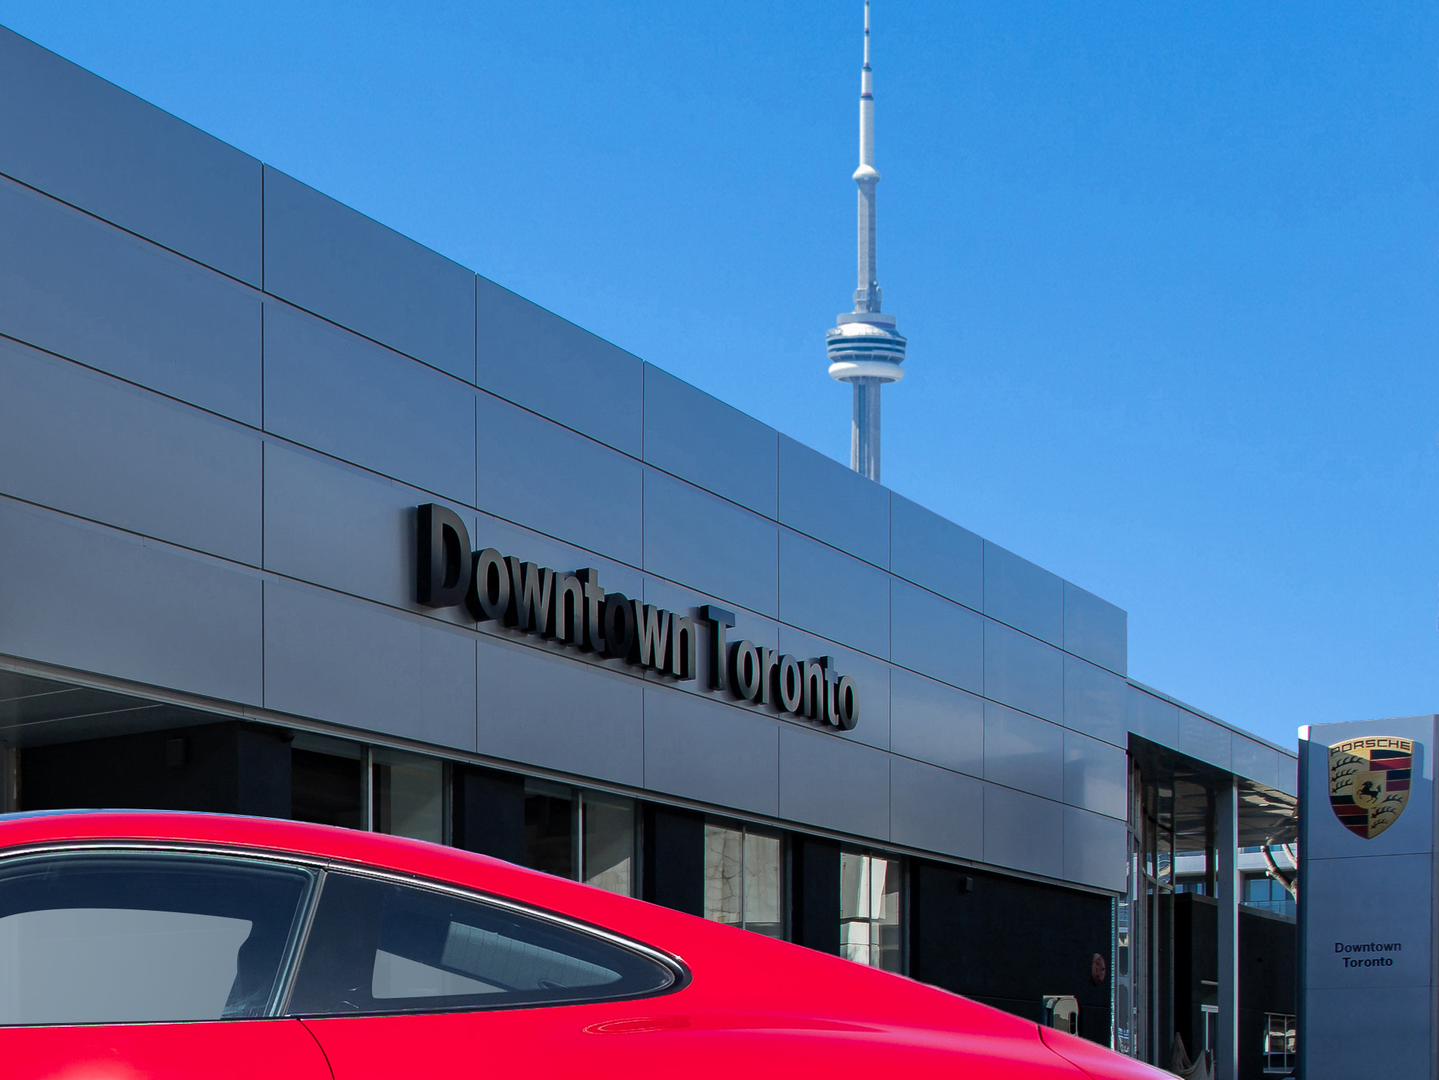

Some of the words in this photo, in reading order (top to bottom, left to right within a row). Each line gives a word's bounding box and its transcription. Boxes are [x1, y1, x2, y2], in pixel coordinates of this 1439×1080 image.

[417, 502, 696, 681] Downtown
[700, 604, 860, 731] Toronto
[1330, 739, 1411, 757] PORSCHE
[1334, 942, 1402, 954] Downtown
[1342, 956, 1393, 968] Toronto
